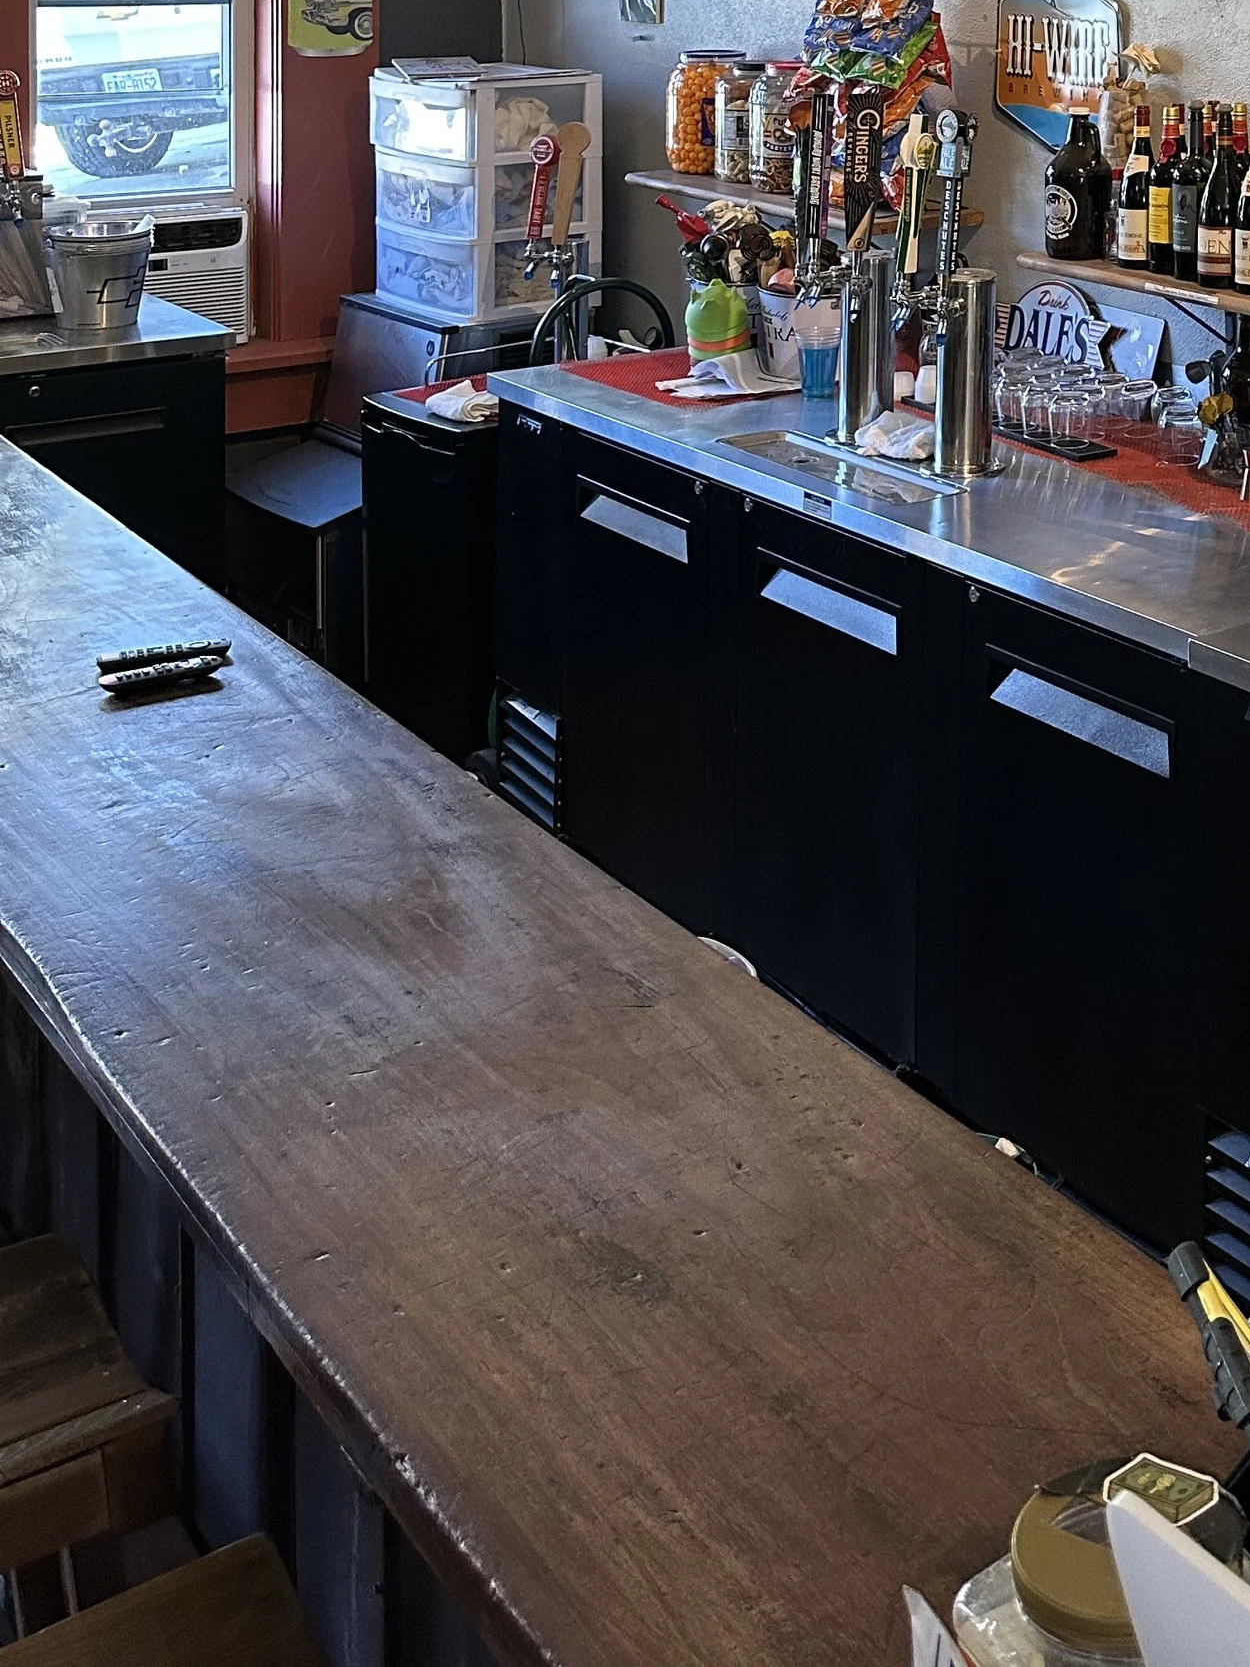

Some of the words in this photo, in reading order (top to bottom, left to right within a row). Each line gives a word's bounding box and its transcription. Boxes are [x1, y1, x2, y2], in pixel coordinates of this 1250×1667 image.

[4, 115, 15, 149] PILSNER
[854, 109, 881, 183] GINGER'S
[939, 180, 952, 271] DESCHUTES
[1004, 304, 1090, 365] DALE'S
